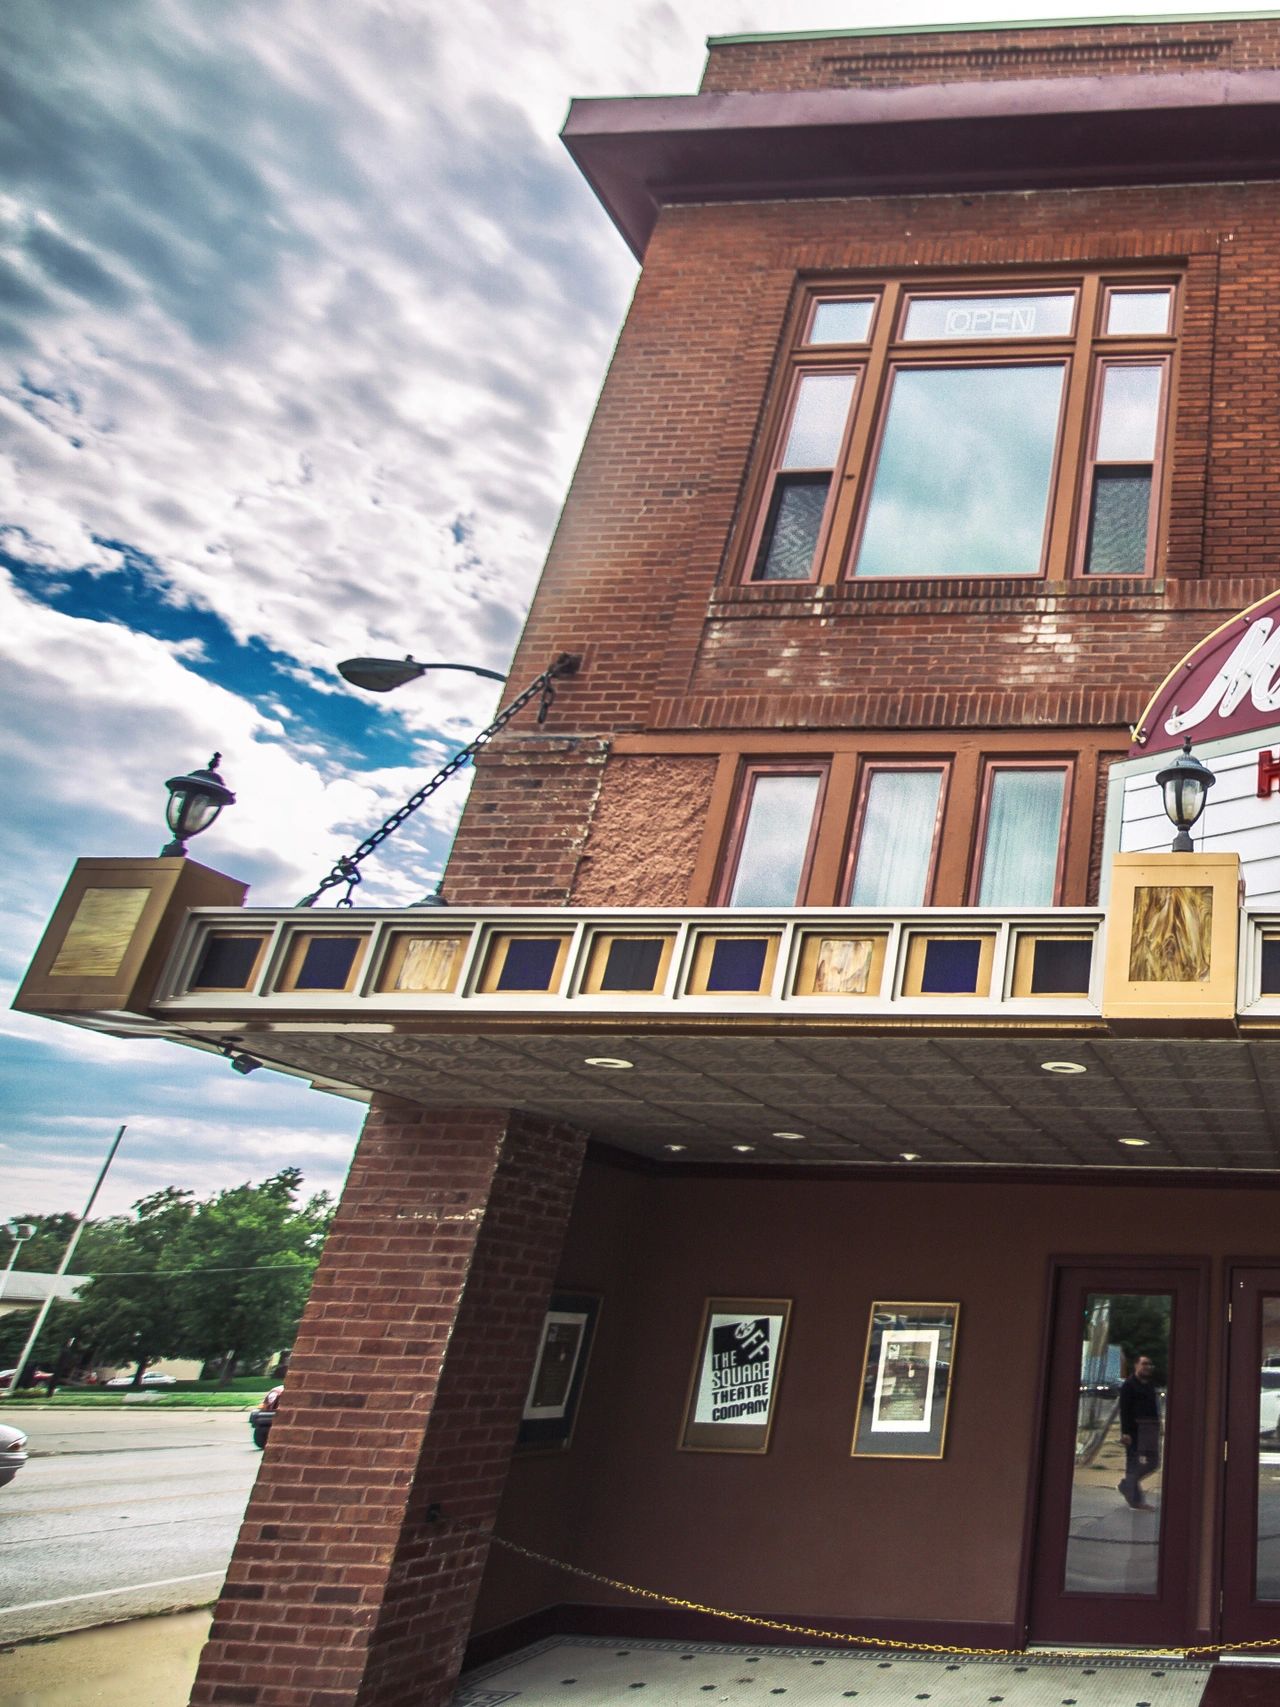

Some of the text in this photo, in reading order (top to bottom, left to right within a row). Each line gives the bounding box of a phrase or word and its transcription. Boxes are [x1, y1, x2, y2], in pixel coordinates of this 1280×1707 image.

[951, 309, 1031, 332] OPEN
[713, 1350, 737, 1370] THE
[712, 1361, 770, 1389] SQUARE
[712, 1383, 769, 1405] THEATRE
[712, 1399, 769, 1422] COMPANY
